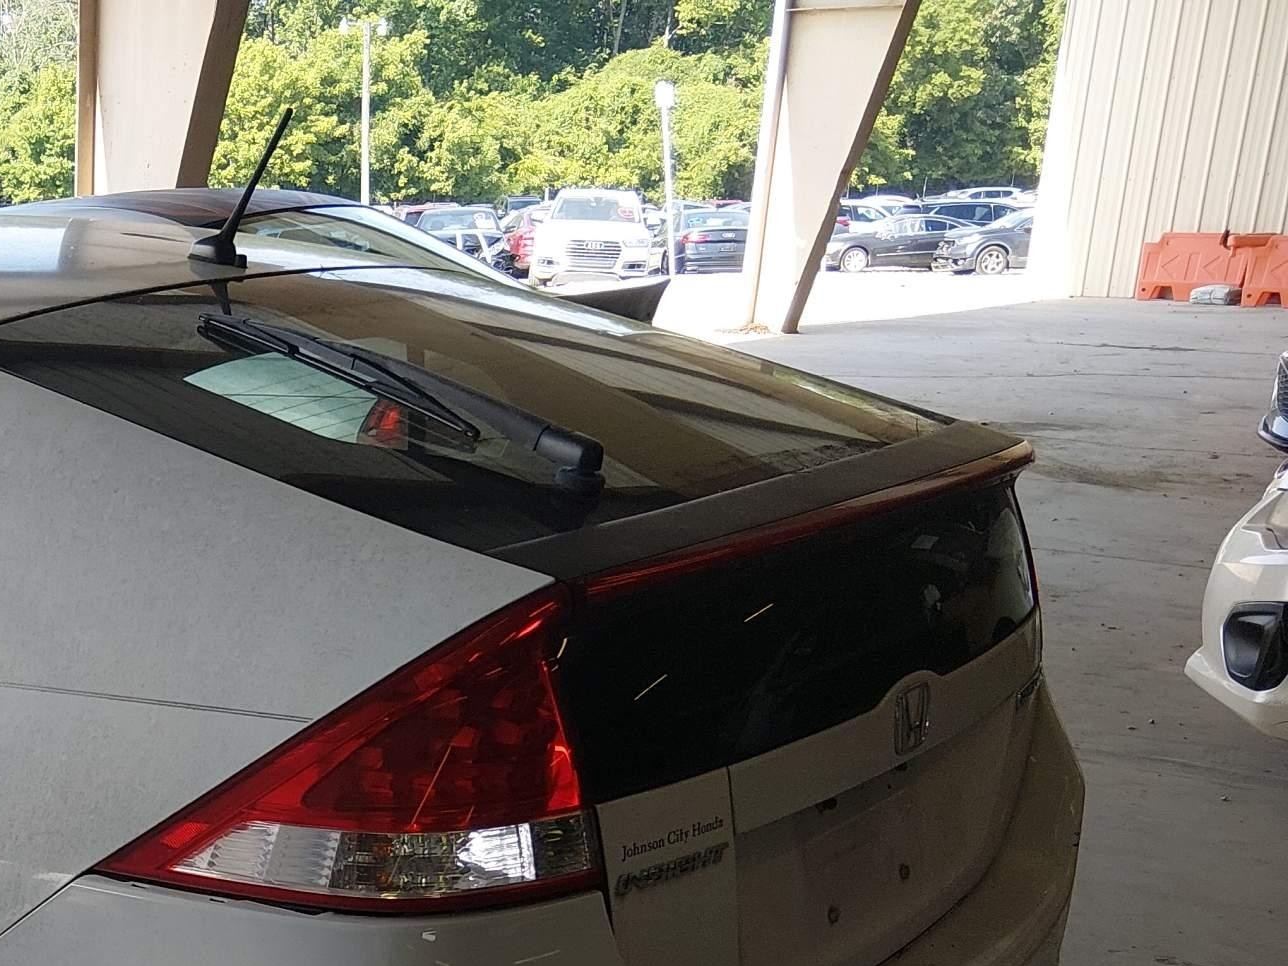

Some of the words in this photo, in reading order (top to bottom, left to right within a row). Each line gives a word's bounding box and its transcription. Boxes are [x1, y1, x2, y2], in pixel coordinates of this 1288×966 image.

[621, 837, 665, 862] Johnson
[667, 829, 691, 845] City
[692, 816, 724, 838] Honda
